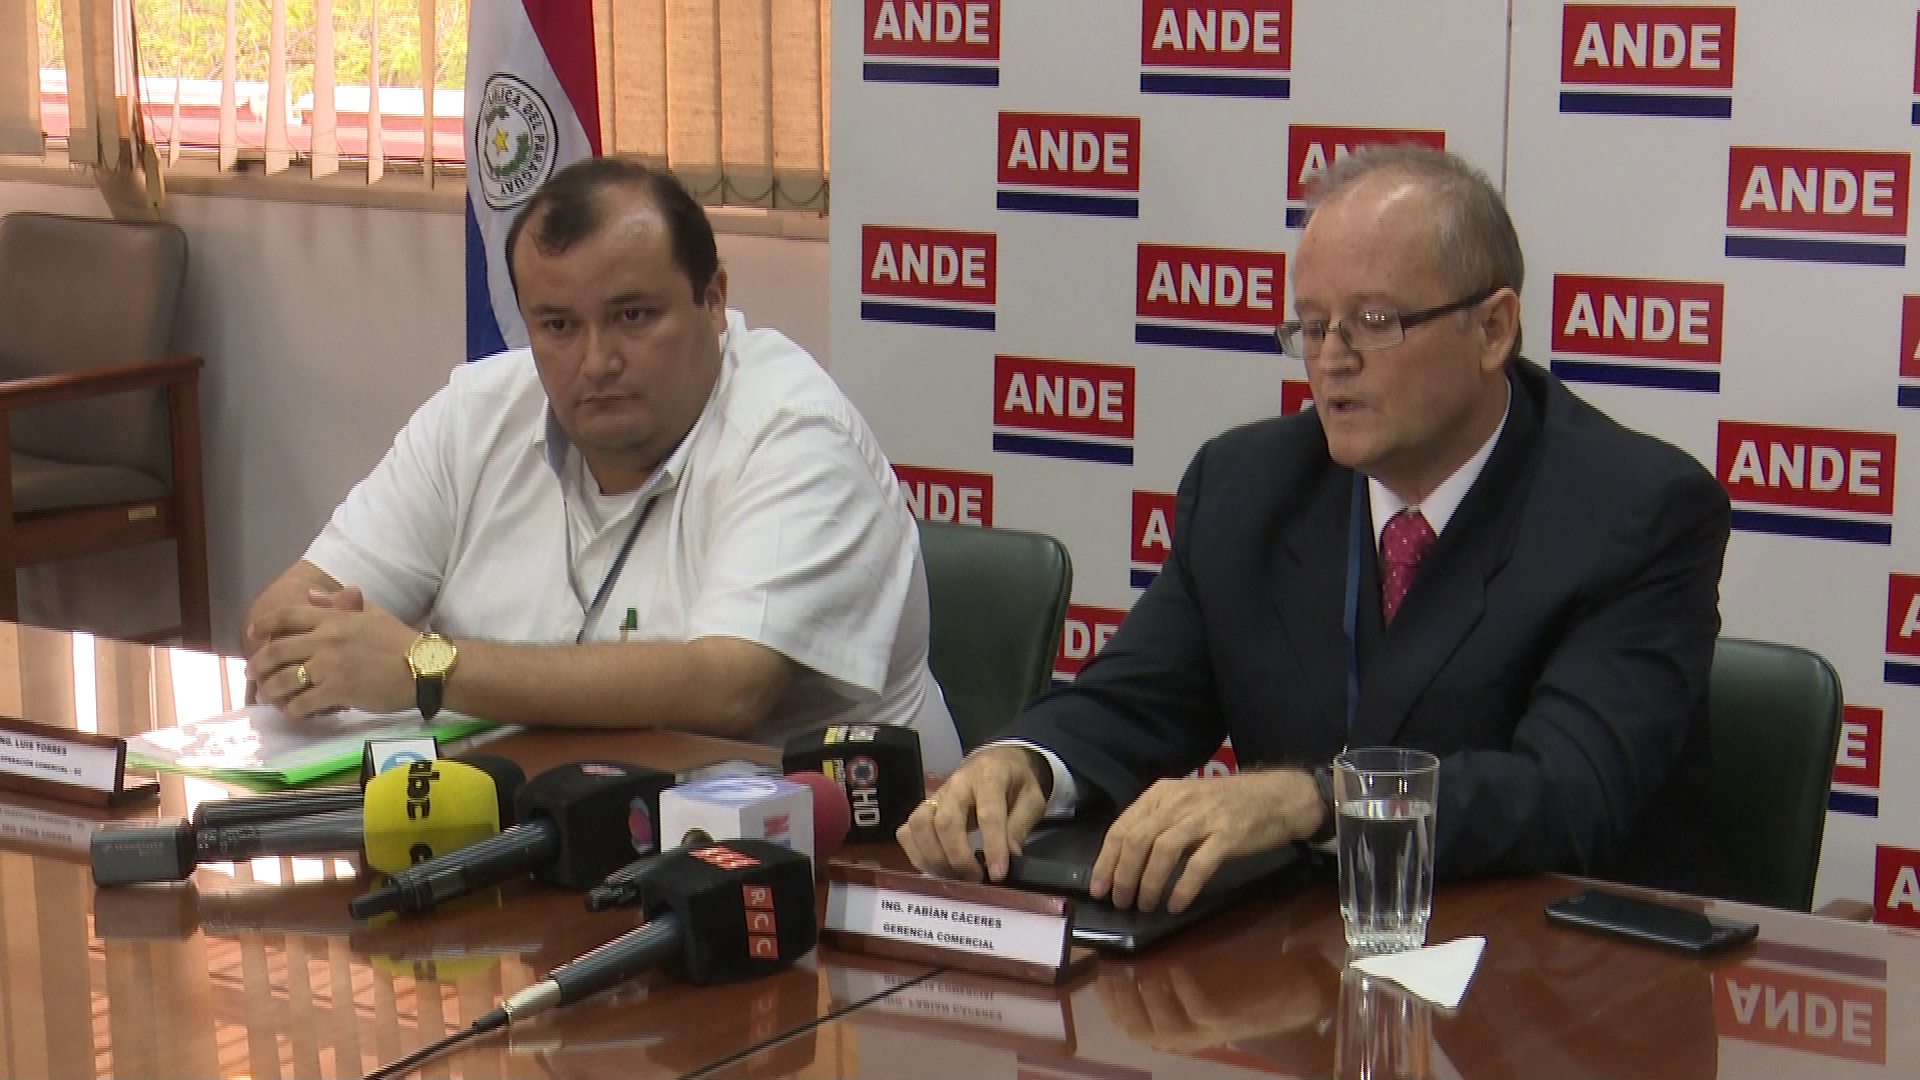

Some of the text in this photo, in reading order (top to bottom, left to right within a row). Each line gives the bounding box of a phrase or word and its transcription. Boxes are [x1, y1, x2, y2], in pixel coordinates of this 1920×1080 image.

[874, 1, 990, 43] ANDE
[1151, 9, 1281, 53] ANDE
[1573, 23, 1722, 70] ANDE
[1008, 129, 1129, 174] ANDE
[1740, 166, 1895, 217] ANDE
[871, 242, 986, 287] ANDE
[1147, 261, 1274, 309] ANDE
[1564, 293, 1710, 345] ANDE
[1004, 372, 1124, 421] ANDE
[1727, 440, 1882, 496] ANDE
[899, 481, 983, 524] NDE
[407, 760, 440, 820] abc
[851, 787, 881, 827] HD
[750, 888, 772, 955] RCC
[882, 899, 904, 912] ING.
[883, 922, 995, 949] GERENCIA COMERCIAL
